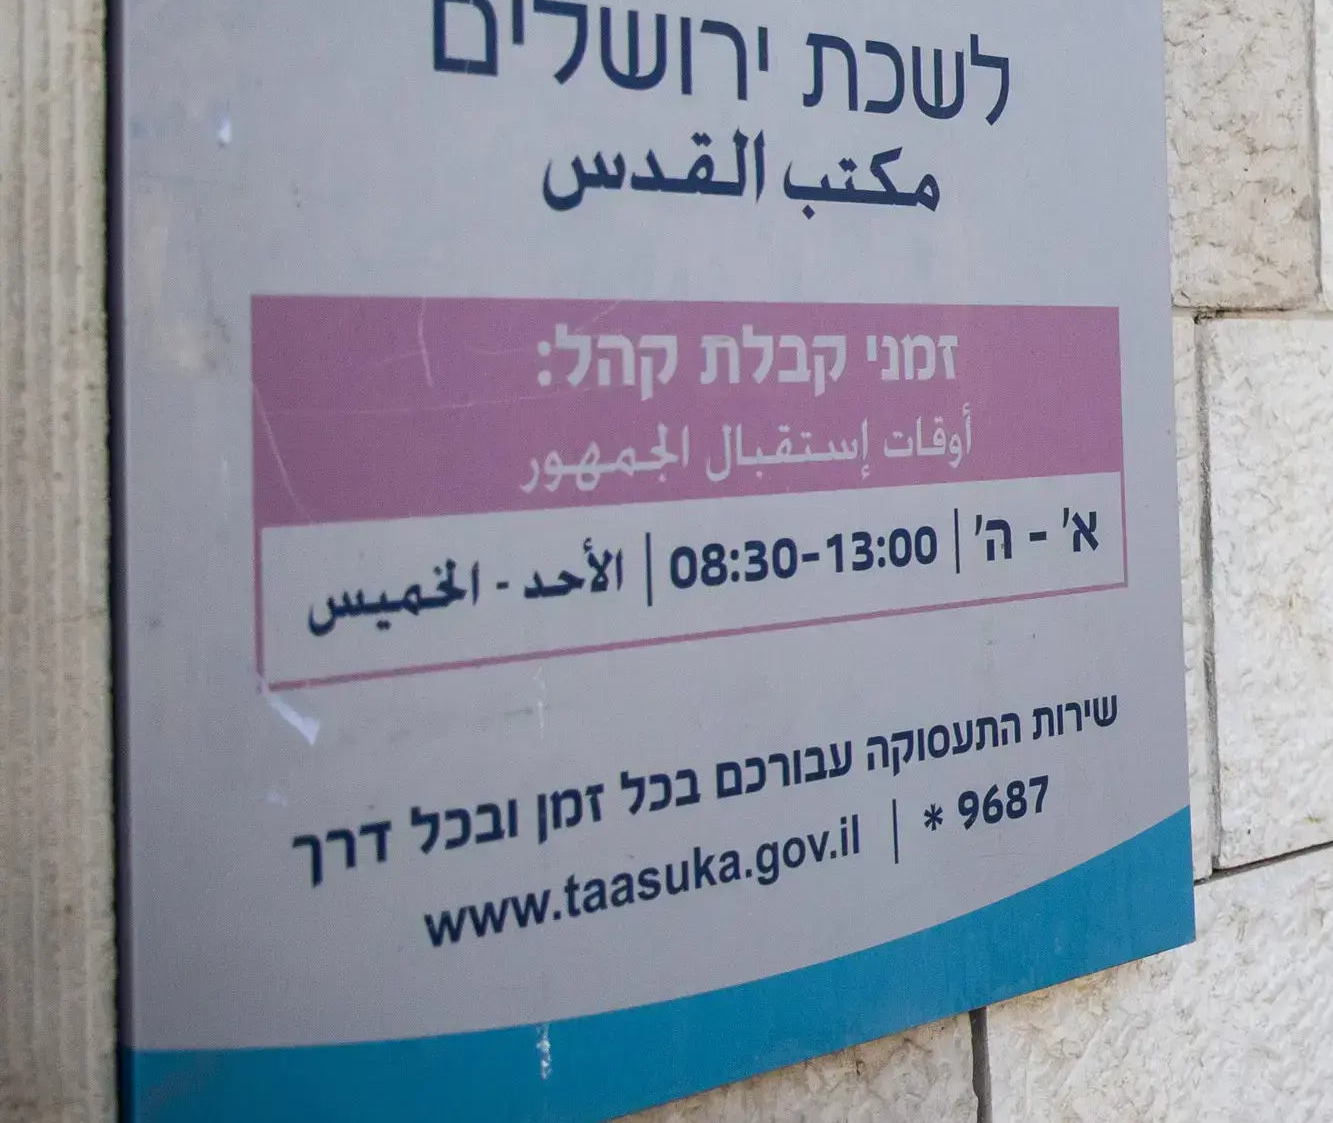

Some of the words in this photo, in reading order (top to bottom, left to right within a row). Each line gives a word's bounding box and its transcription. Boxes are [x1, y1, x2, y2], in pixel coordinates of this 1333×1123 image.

[802, 32, 1011, 127] לשכת
[541, 127, 766, 213] القدس
[782, 146, 941, 220] مكتب
[537, 323, 678, 401] קהל:
[700, 326, 847, 397] קבלת
[866, 334, 959, 381] זמני
[520, 423, 689, 493] الجمهور
[706, 419, 870, 482] إستقبال
[883, 402, 972, 469] أوقات
[523, 537, 624, 600] الأحد
[669, 525, 938, 590] 08:30-13:00
[307, 558, 480, 638] الخميس
[865, 712, 1022, 777] התעסוקה
[1031, 694, 1118, 741] שירות
[619, 768, 702, 816] בכל
[715, 740, 853, 800] עבורכם
[957, 774, 1050, 831] 9687
[409, 798, 519, 855] ובכל
[536, 783, 605, 845] זמן
[291, 820, 392, 888] דרך
[423, 814, 861, 948] www.taasuka.gov.il
